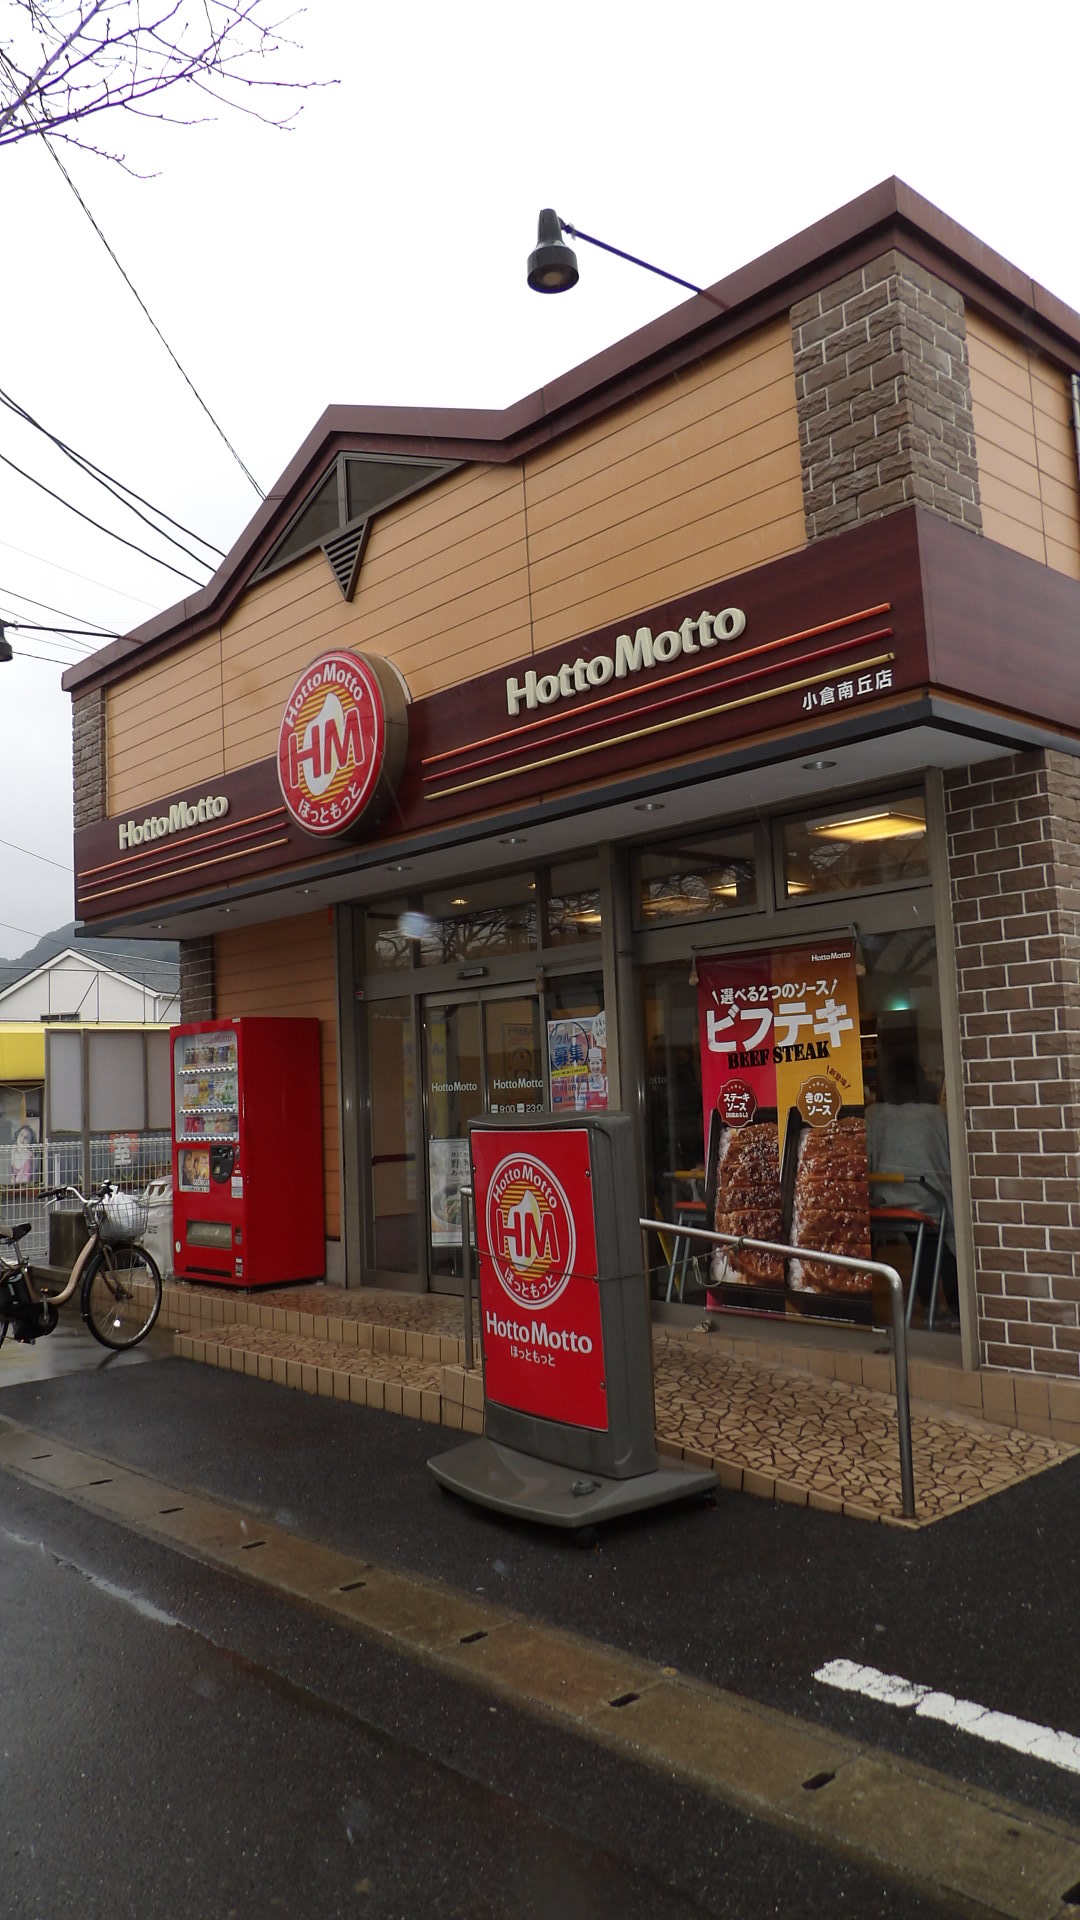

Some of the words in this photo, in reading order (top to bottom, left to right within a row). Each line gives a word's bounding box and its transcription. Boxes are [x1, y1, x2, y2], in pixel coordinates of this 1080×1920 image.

[506, 607, 747, 716] HottoMotto
[285, 662, 363, 728] HottoMotto
[802, 669, 893, 711] 小倉南丘店
[288, 706, 365, 789] HM
[298, 782, 361, 824] ほっともっと
[118, 796, 229, 850] HottoMotto
[811, 951, 851, 962] HottoMotto
[720, 980, 830, 1005] 選べる2つのソース
[706, 998, 854, 1053] ビフテキ
[728, 1049, 770, 1070] BEEF
[773, 1040, 831, 1064] STEAK
[431, 1081, 478, 1092] HottoMotto
[493, 1078, 544, 1090] HottoMotto
[723, 1093, 750, 1102] ステーキ
[805, 1092, 833, 1104] きのこ
[727, 1102, 747, 1112] ソース
[808, 1106, 832, 1116] ソース
[492, 1163, 558, 1210] HottoMotto
[495, 1208, 561, 1263] HM
[504, 1266, 557, 1299] ほっともっと
[486, 1310, 593, 1354] HottoMotto
[510, 1344, 556, 1367] ほっともっと
